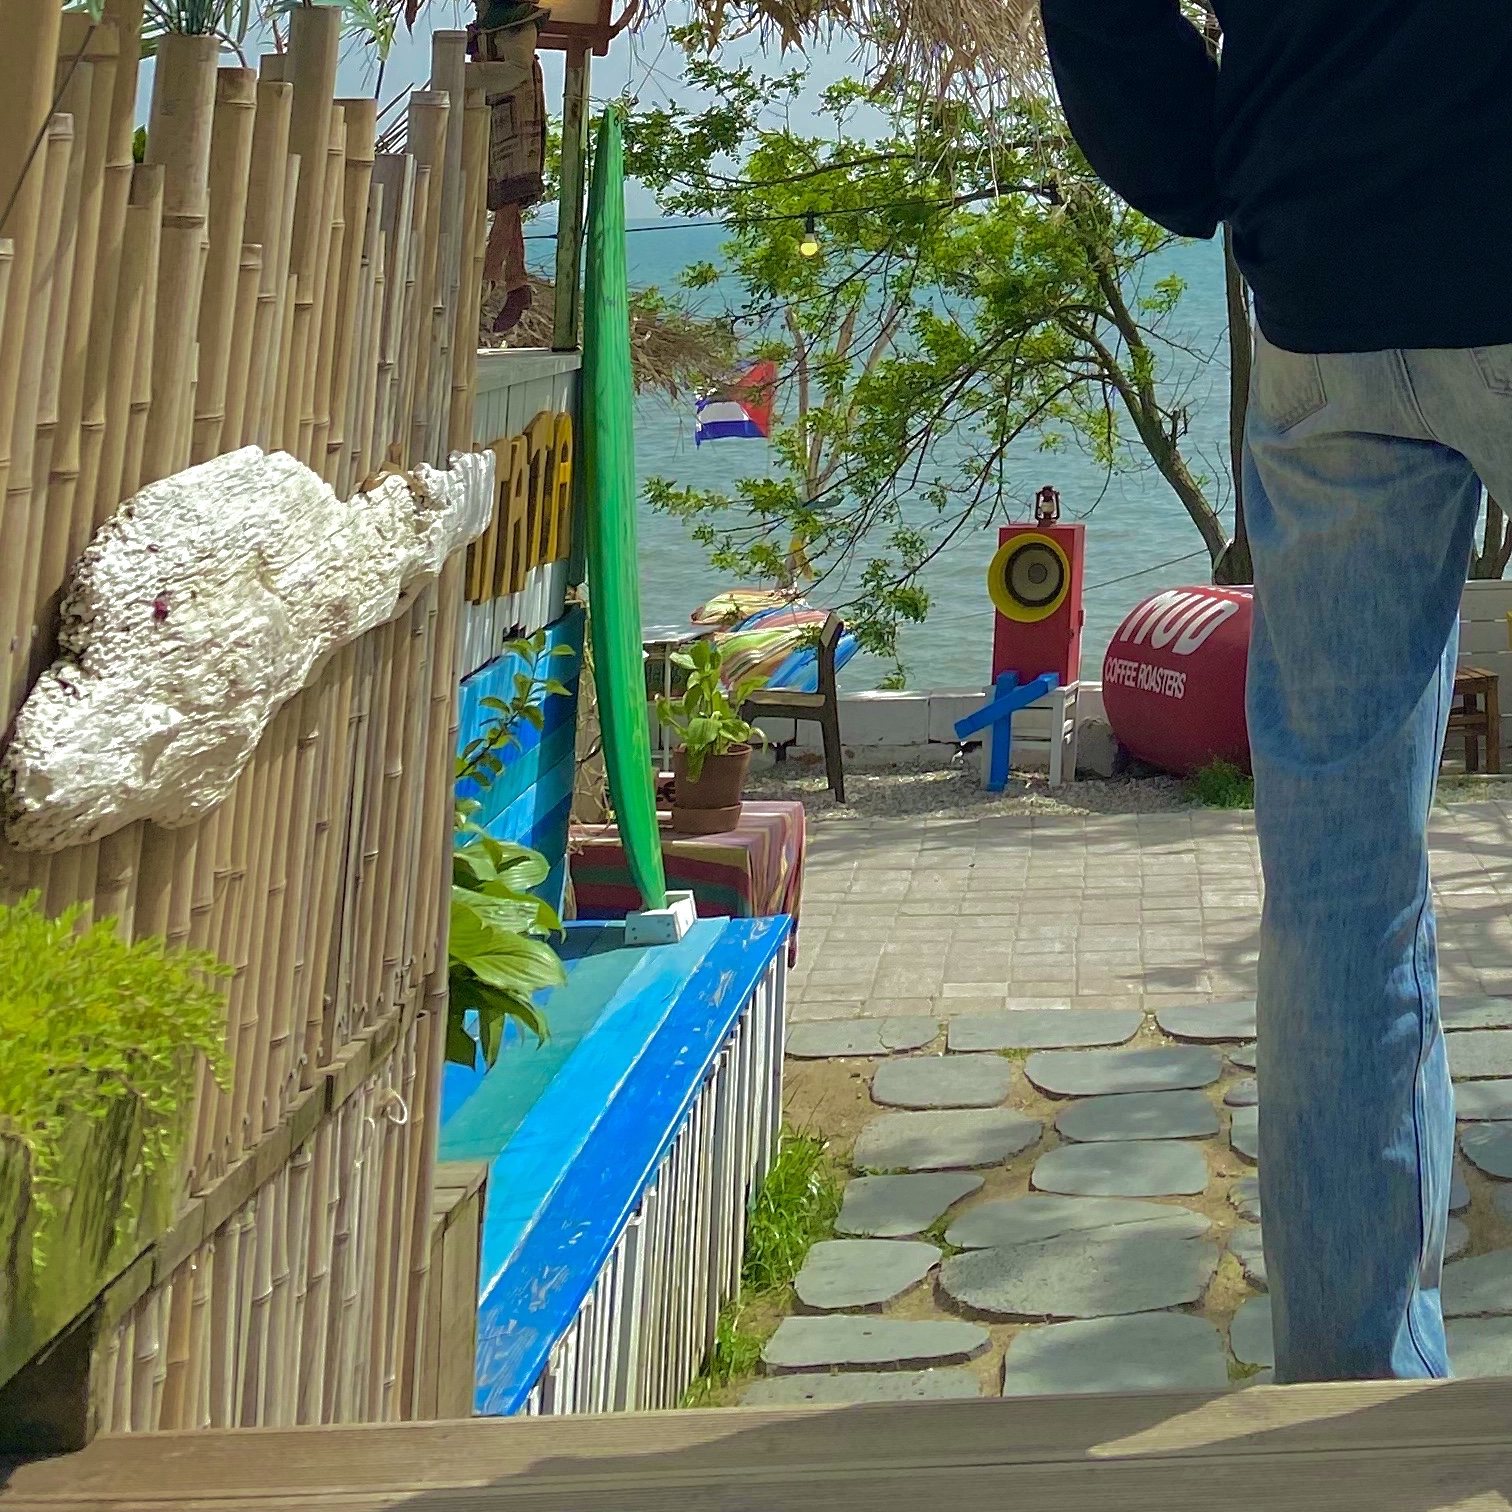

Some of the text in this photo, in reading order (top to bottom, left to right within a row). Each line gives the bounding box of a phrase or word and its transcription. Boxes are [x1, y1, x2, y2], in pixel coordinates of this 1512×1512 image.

[1119, 590, 1240, 656] MUD
[1104, 656, 1187, 700] COFFEE ROASTERS
